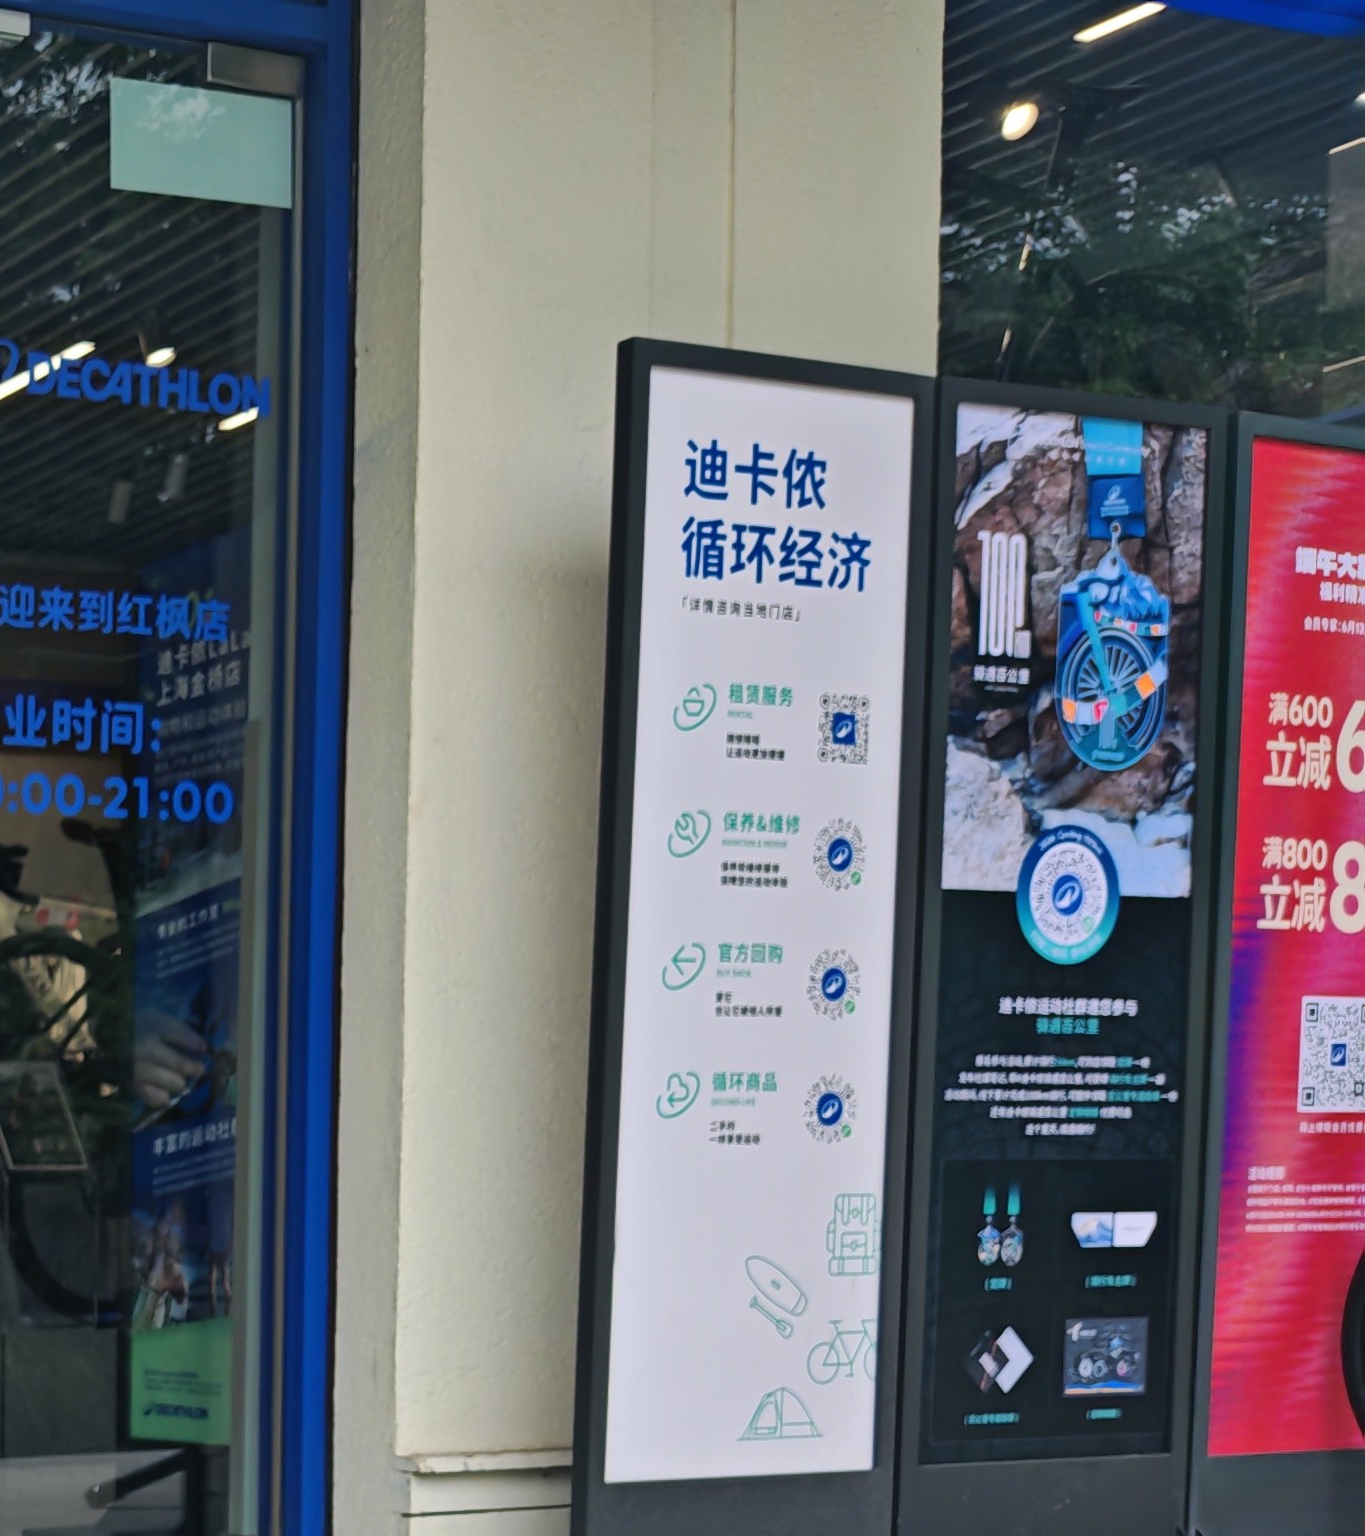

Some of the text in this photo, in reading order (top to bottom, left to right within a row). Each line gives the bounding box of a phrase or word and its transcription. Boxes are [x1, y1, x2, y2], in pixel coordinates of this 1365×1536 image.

[26, 350, 270, 417] DECATHLON
[683, 439, 827, 510] 迪卡侬
[681, 516, 872, 593] 循环经济
[729, 683, 793, 707] 租赁服务
[1268, 692, 1333, 728] 满600
[1263, 731, 1332, 791] 立减
[1262, 836, 1329, 871] 满800
[1256, 875, 1325, 934] 立减
[718, 943, 783, 965] 官方回购
[712, 1071, 777, 1092] 循环商品
